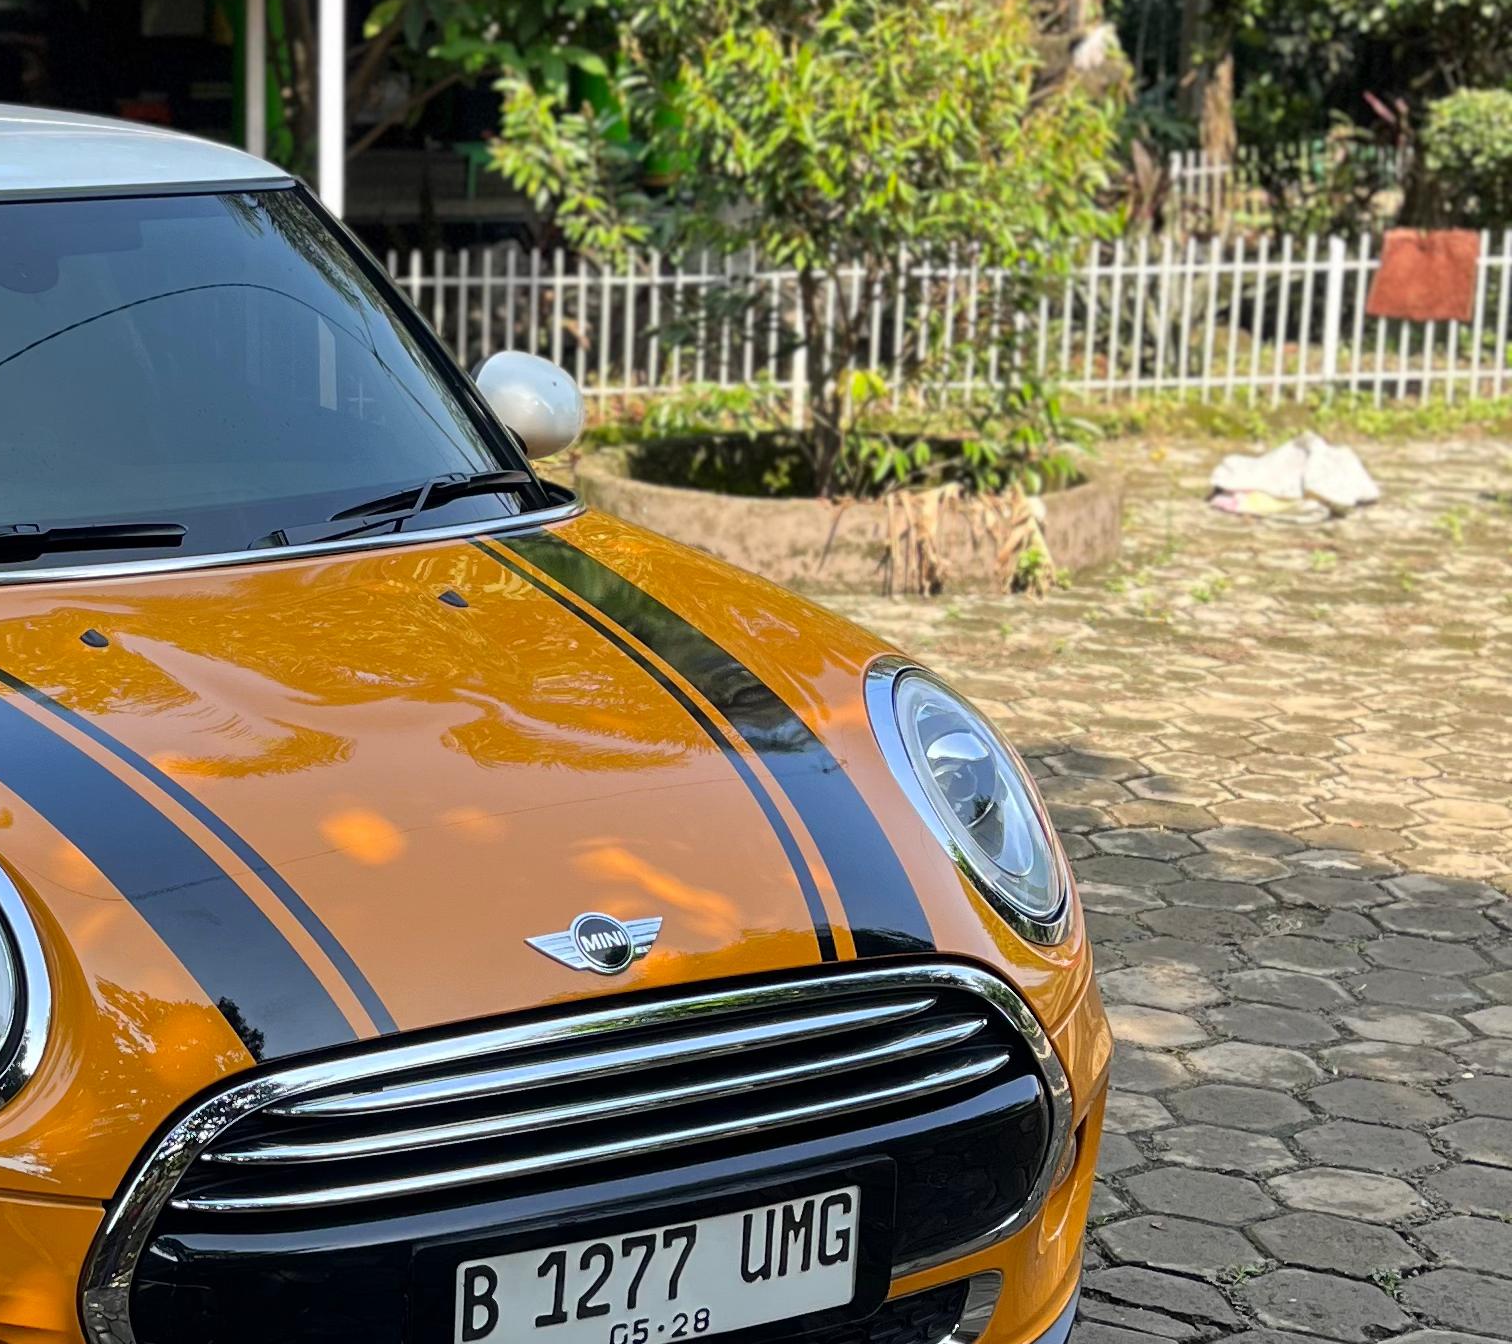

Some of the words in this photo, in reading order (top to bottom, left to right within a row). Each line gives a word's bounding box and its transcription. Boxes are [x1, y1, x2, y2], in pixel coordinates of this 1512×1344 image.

[579, 930, 628, 952] MINI
[461, 1264, 500, 1343] B
[534, 1224, 698, 1329] 1277
[740, 1192, 852, 1284] UMG
